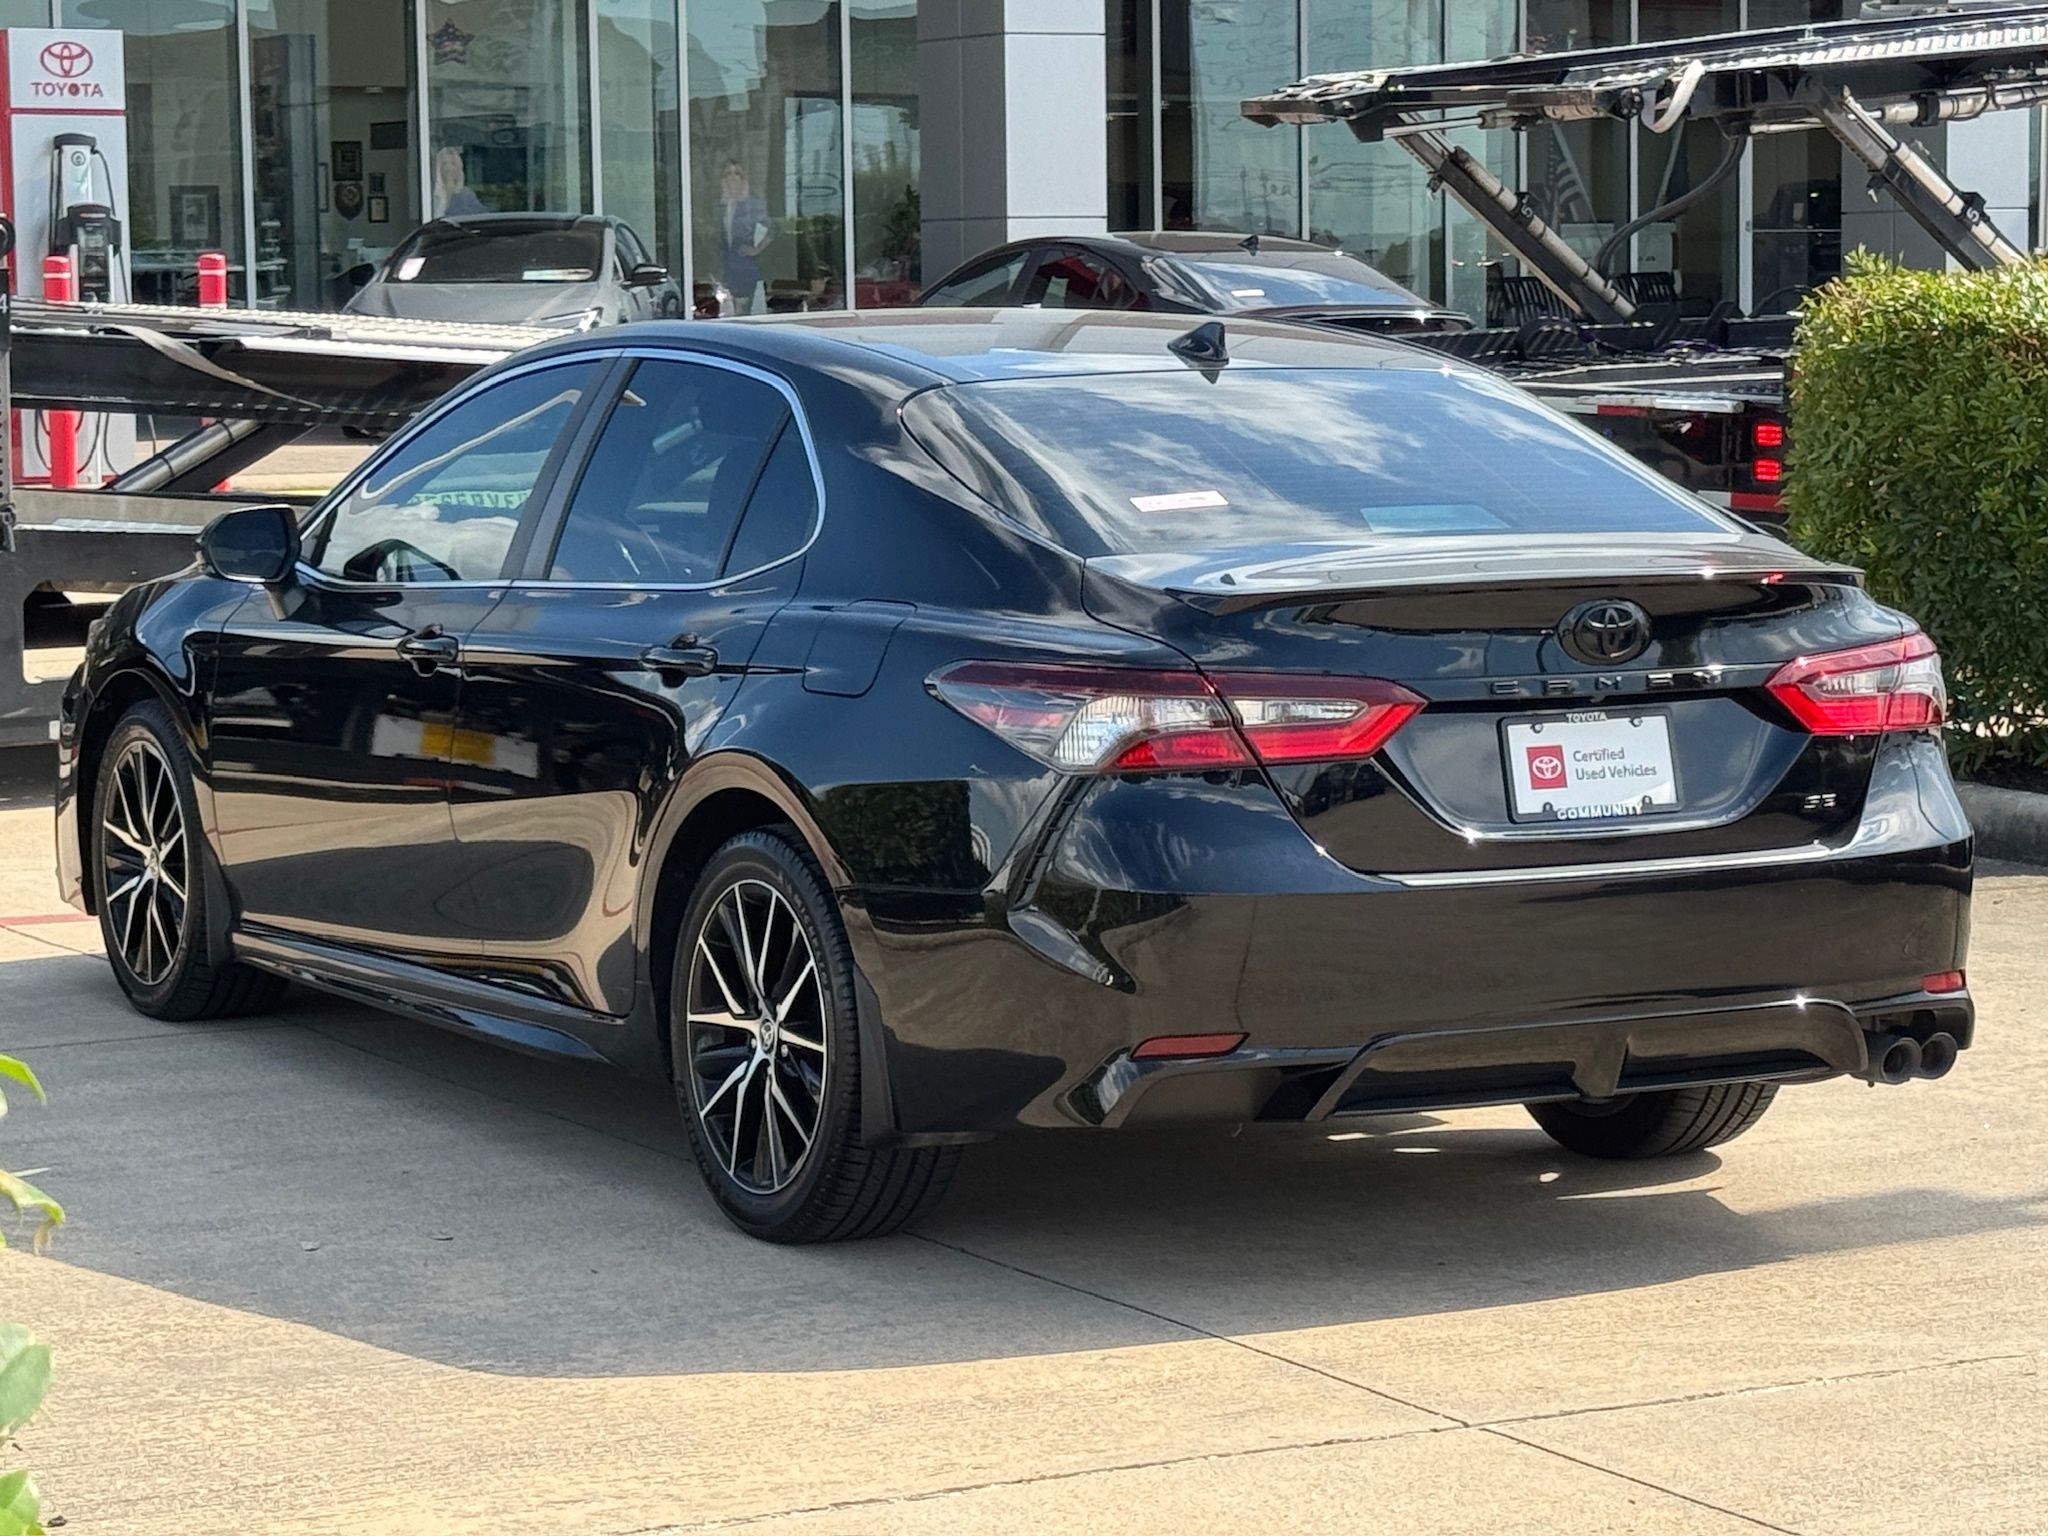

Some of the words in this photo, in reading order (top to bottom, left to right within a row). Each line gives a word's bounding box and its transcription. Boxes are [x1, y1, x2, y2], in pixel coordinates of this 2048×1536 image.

[31, 81, 104, 98] TOYOTA
[1966, 206, 1980, 223] 5
[1566, 712, 1608, 724] TOYOTA
[1573, 747, 1625, 763] Certified
[1576, 767, 1606, 781] Used
[1608, 764, 1657, 779] Vehicles
[1556, 803, 1643, 821] COMMUNITY
